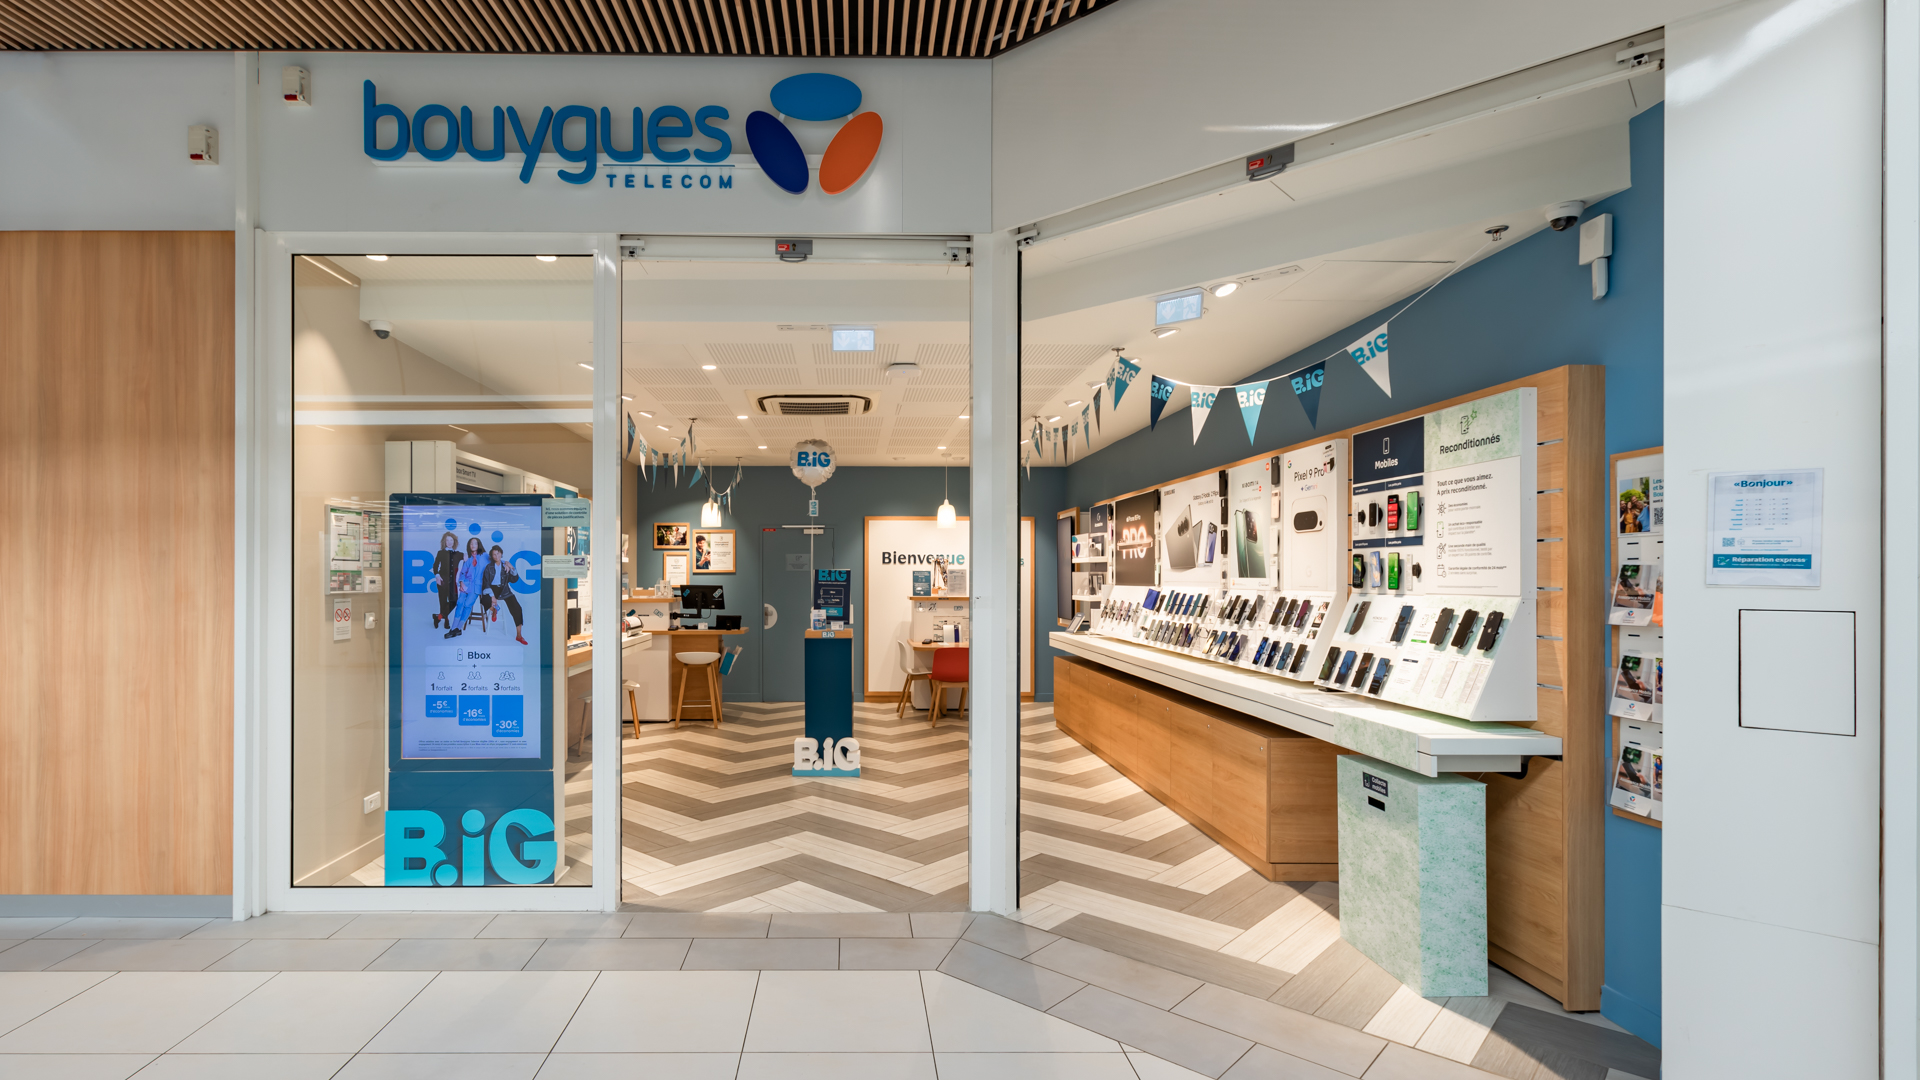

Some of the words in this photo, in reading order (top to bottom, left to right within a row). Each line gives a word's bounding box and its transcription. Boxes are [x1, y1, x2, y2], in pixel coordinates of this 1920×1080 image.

[363, 79, 733, 184] bouygues
[606, 174, 733, 189] TELECOM
[1440, 434, 1500, 454] Reconditionnés
[1374, 457, 1399, 470] Mobiles
[1294, 469, 1308, 482] Pixel
[1308, 468, 1313, 478] 9
[1314, 467, 1324, 478] Pro
[1451, 483, 1487, 494] reconditionné.
[468, 651, 491, 660] Bbox
